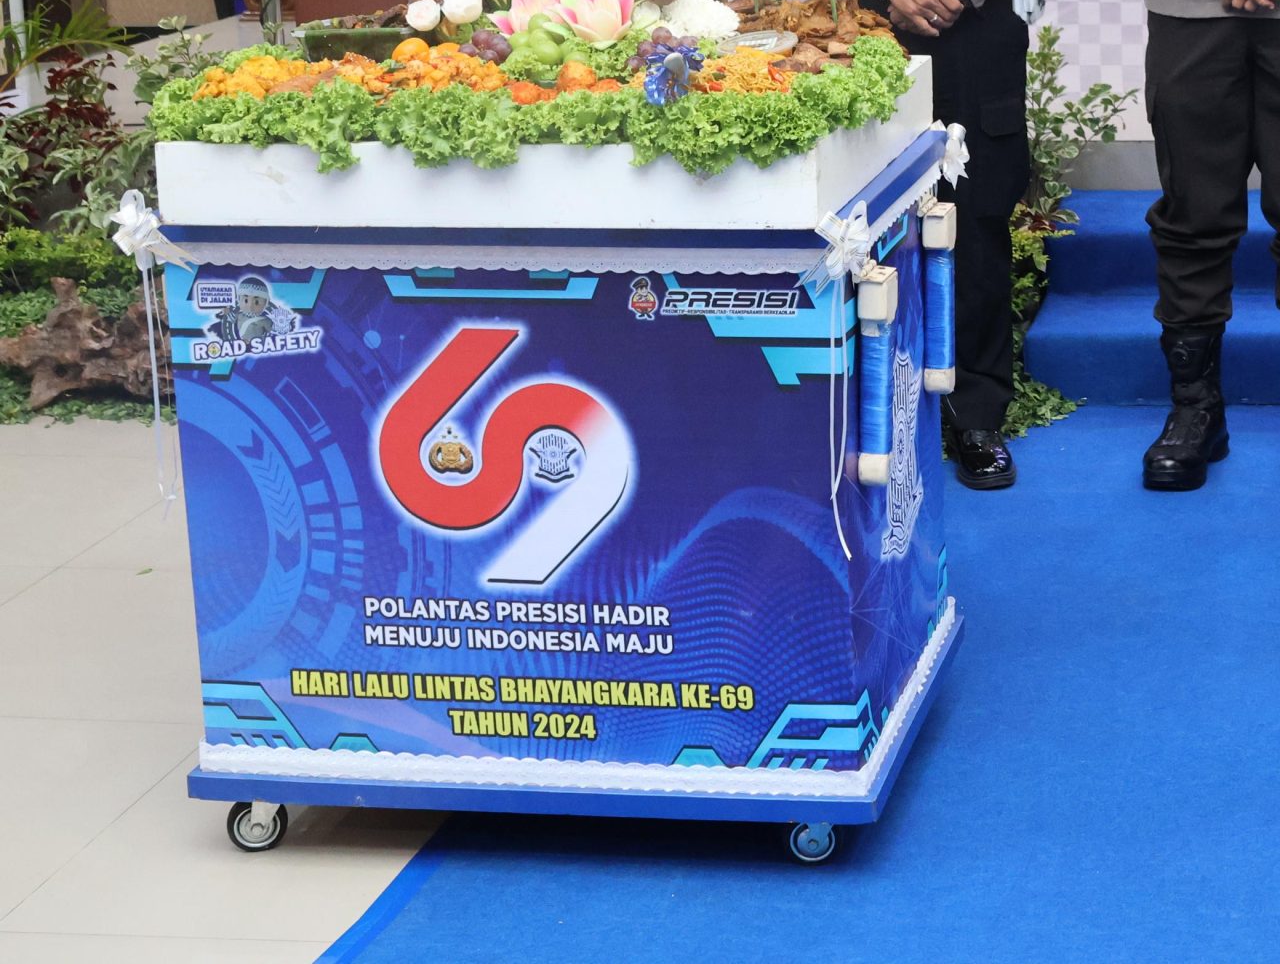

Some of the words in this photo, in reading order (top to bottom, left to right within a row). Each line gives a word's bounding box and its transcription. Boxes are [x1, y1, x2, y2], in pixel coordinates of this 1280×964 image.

[664, 290, 798, 309] PRESISI
[194, 339, 246, 360] ROAD
[250, 330, 320, 354] SAFETY
[363, 597, 490, 622] POLANTAS
[495, 601, 588, 625] PRESISI
[592, 605, 671, 628] HADIR
[363, 624, 461, 649] MENUJU
[466, 628, 600, 653] INDONESIA
[605, 633, 674, 656] MAJU
[291, 669, 349, 698] HARI
[353, 672, 410, 700] LALU
[413, 675, 496, 703] LINTAS
[500, 680, 677, 709] BHAYANGKARA
[681, 684, 755, 711] KE-69
[448, 708, 530, 738] TAHUN
[533, 713, 597, 741] 2024
